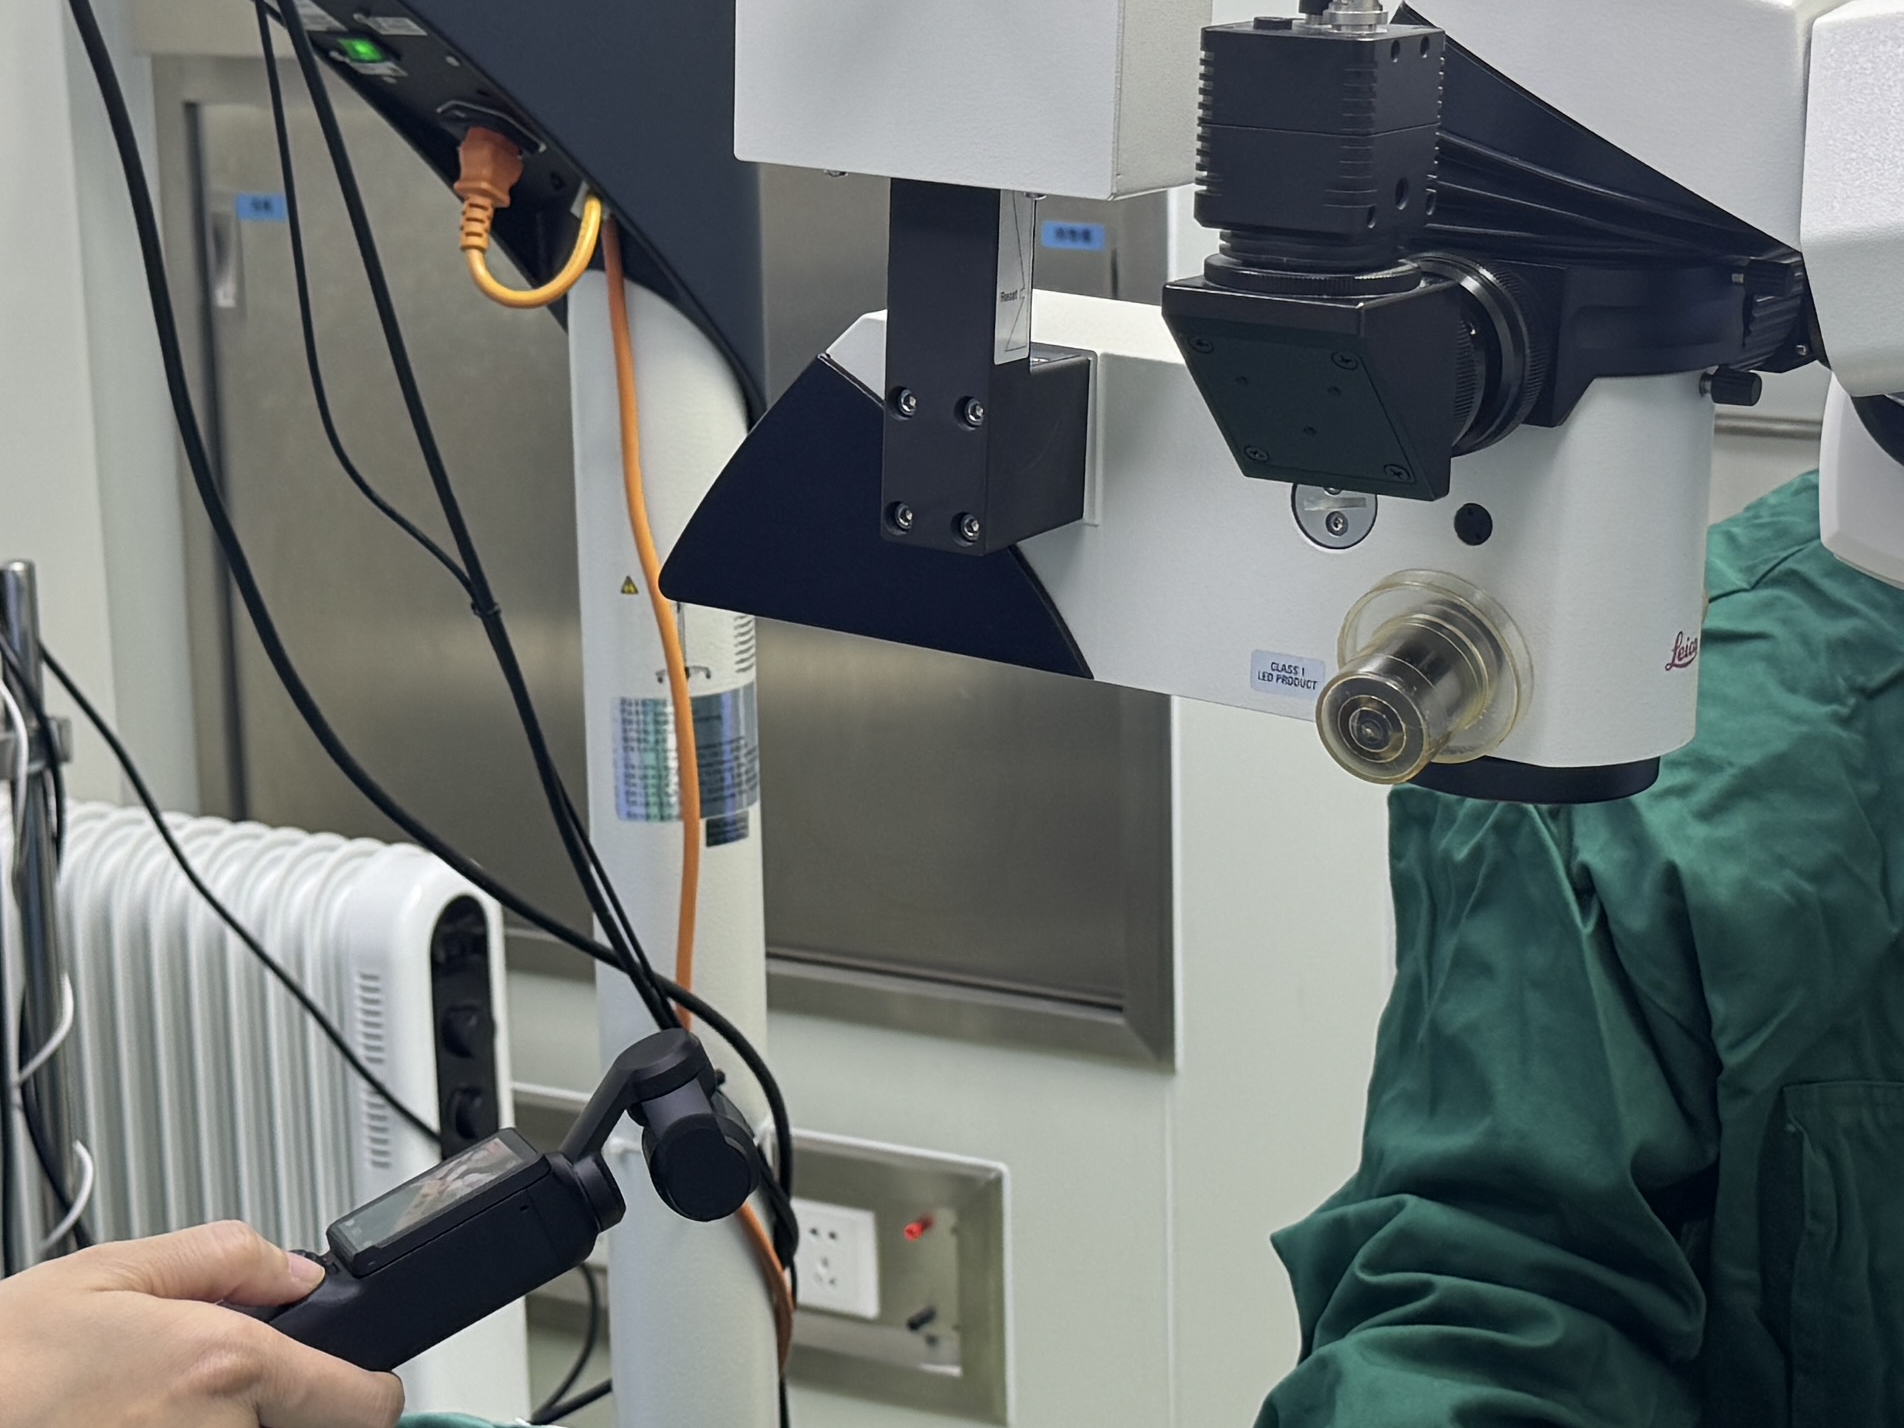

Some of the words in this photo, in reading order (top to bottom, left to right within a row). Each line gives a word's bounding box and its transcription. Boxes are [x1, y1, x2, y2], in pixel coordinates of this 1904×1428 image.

[1270, 661, 1300, 676] CLASS
[1257, 670, 1274, 682] LED
[1275, 674, 1318, 690] PRODUCT
